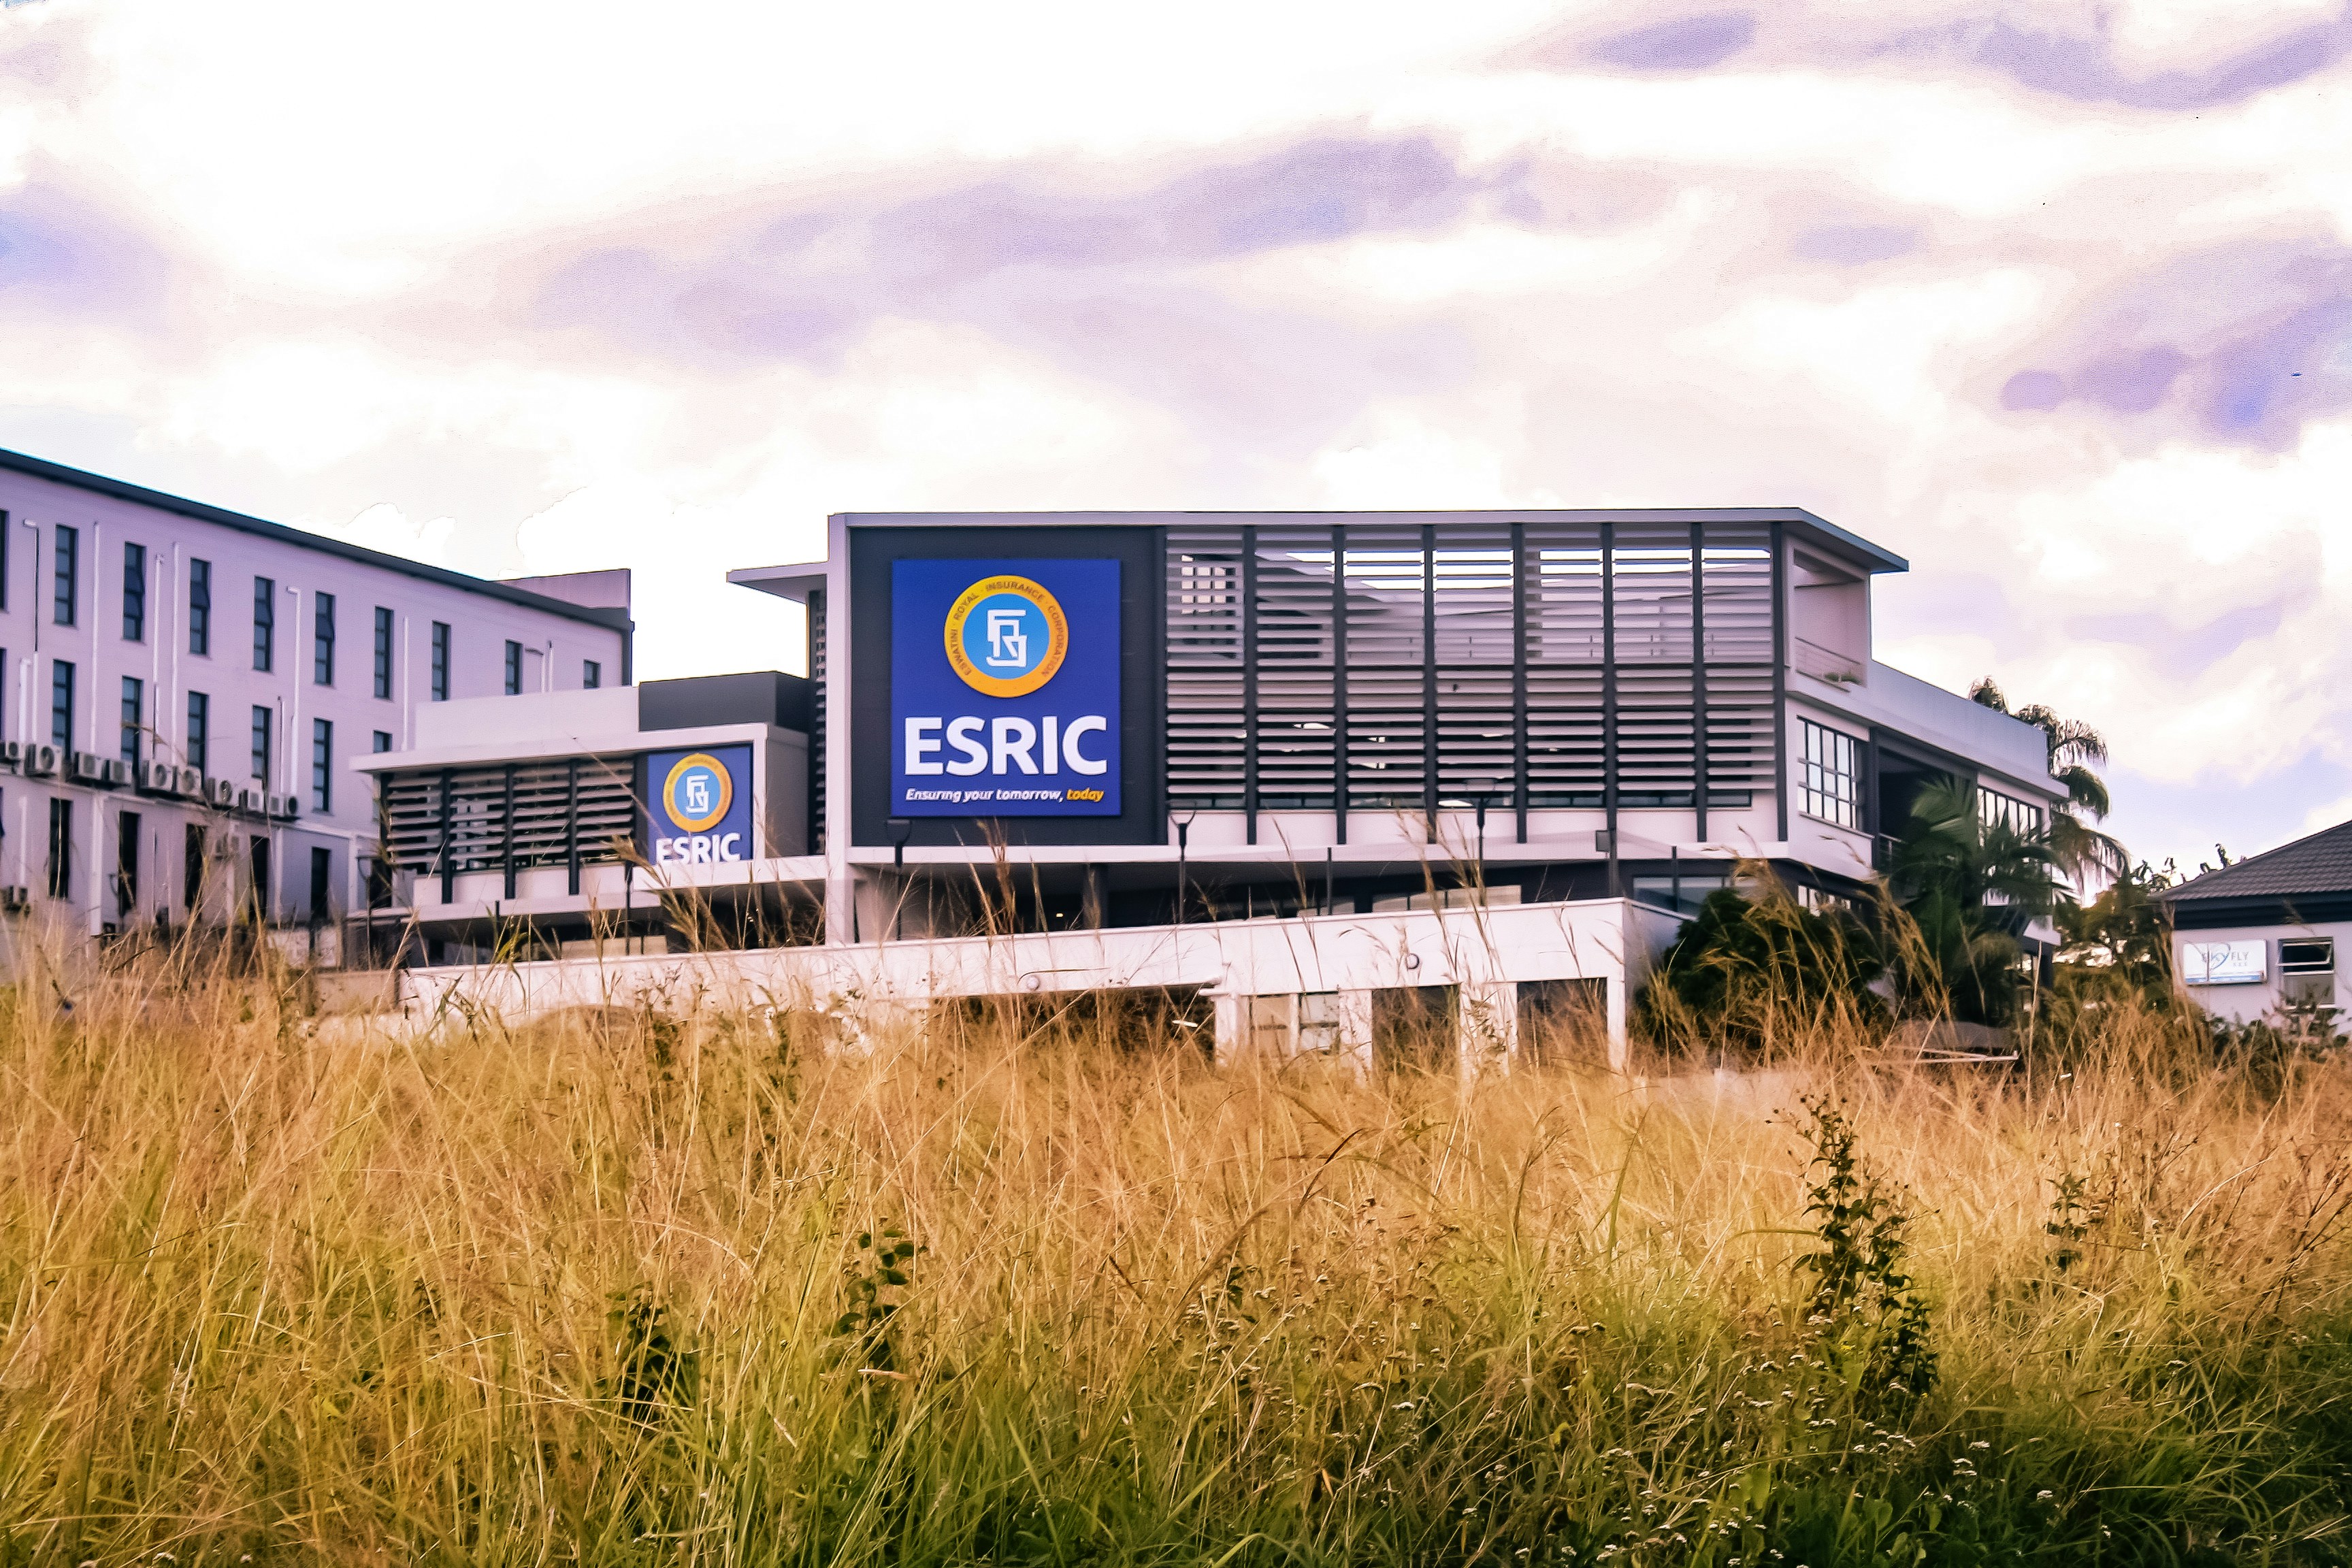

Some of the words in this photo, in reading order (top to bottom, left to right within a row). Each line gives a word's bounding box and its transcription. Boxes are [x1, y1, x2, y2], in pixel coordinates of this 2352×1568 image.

[985, 581, 1045, 602] INSURANCE
[953, 593, 980, 621] ROYAL
[949, 628, 972, 676] ESWATINI
[1041, 604, 1067, 678] CORPORATION
[904, 715, 1107, 776] ESRIC
[905, 787, 962, 802] Ensuring
[962, 789, 994, 802] your
[996, 788, 1064, 802] tomorrow,
[1066, 787, 1105, 802] today
[655, 832, 741, 864] ESRIC
[2231, 951, 2249, 961] FLY
